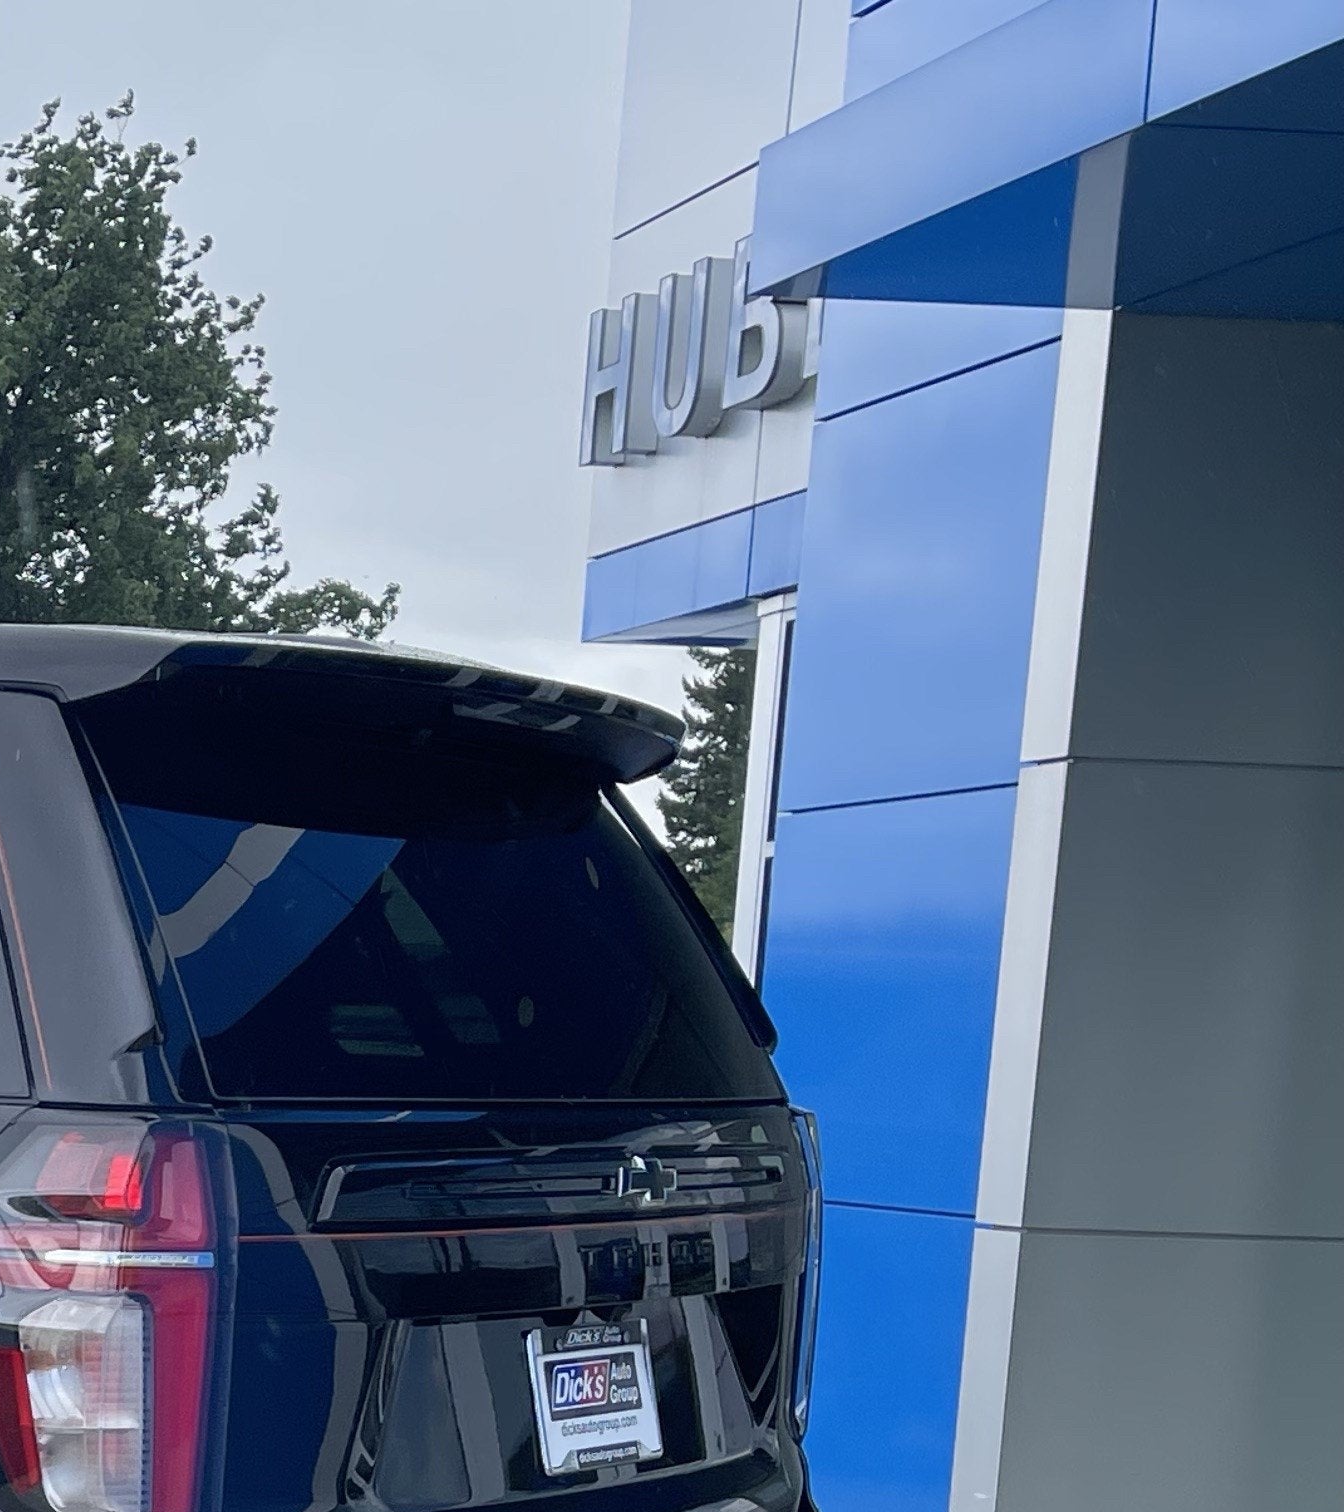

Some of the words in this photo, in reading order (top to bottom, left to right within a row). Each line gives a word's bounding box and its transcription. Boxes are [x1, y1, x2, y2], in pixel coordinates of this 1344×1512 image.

[579, 233, 825, 467] HUB
[555, 1366, 604, 1404] Dick's
[610, 1362, 632, 1380] Auto
[610, 1384, 638, 1405] Group
